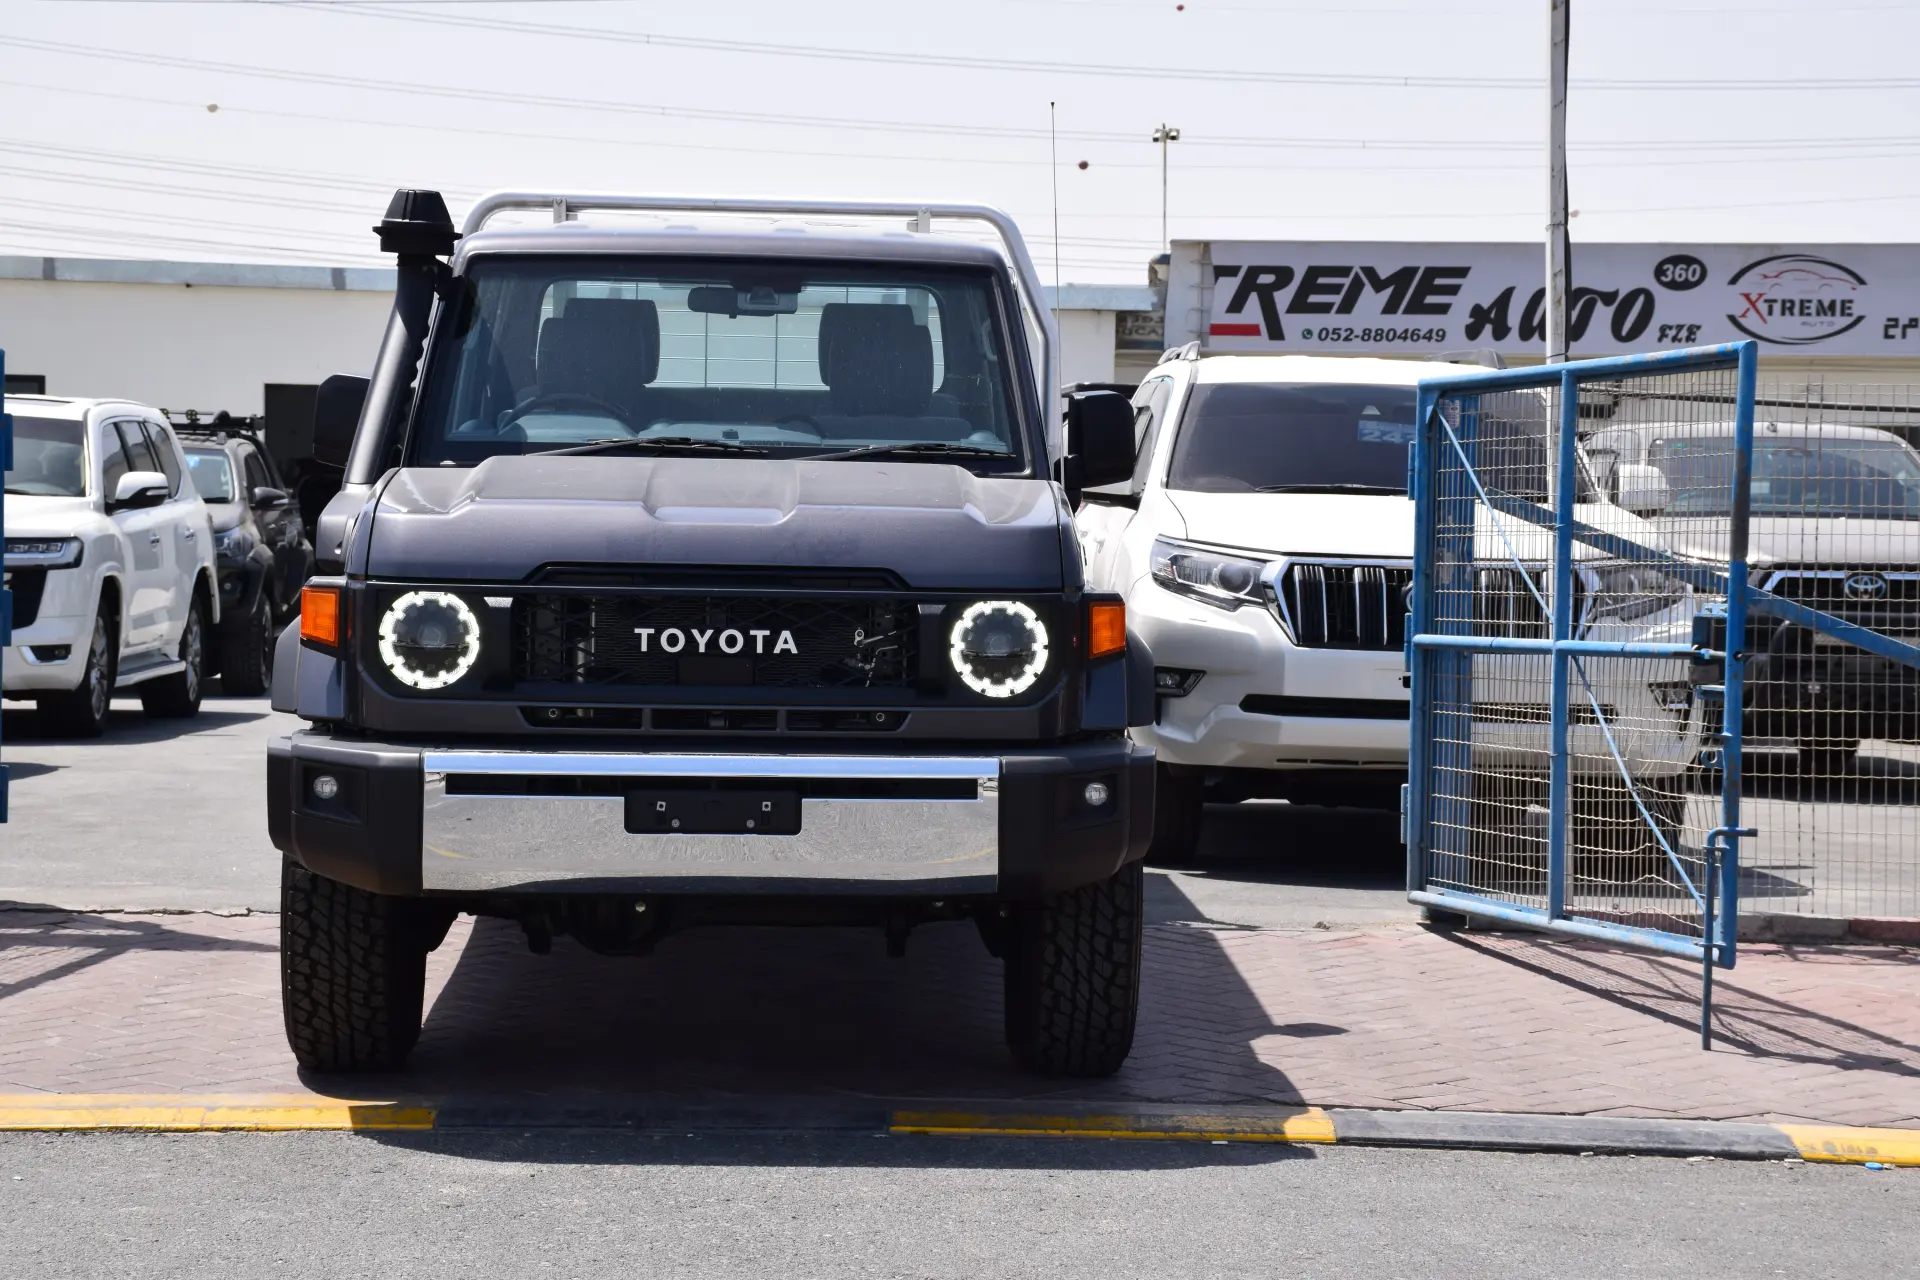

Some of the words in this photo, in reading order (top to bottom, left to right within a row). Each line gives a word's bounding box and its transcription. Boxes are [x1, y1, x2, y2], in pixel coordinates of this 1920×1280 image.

[1660, 264, 1701, 282] 360
[1738, 292, 1855, 324] XTREME
[1317, 327, 1447, 343] 052-8804649
[1657, 323, 1702, 343] FZE
[634, 628, 799, 654] TOYOTA
